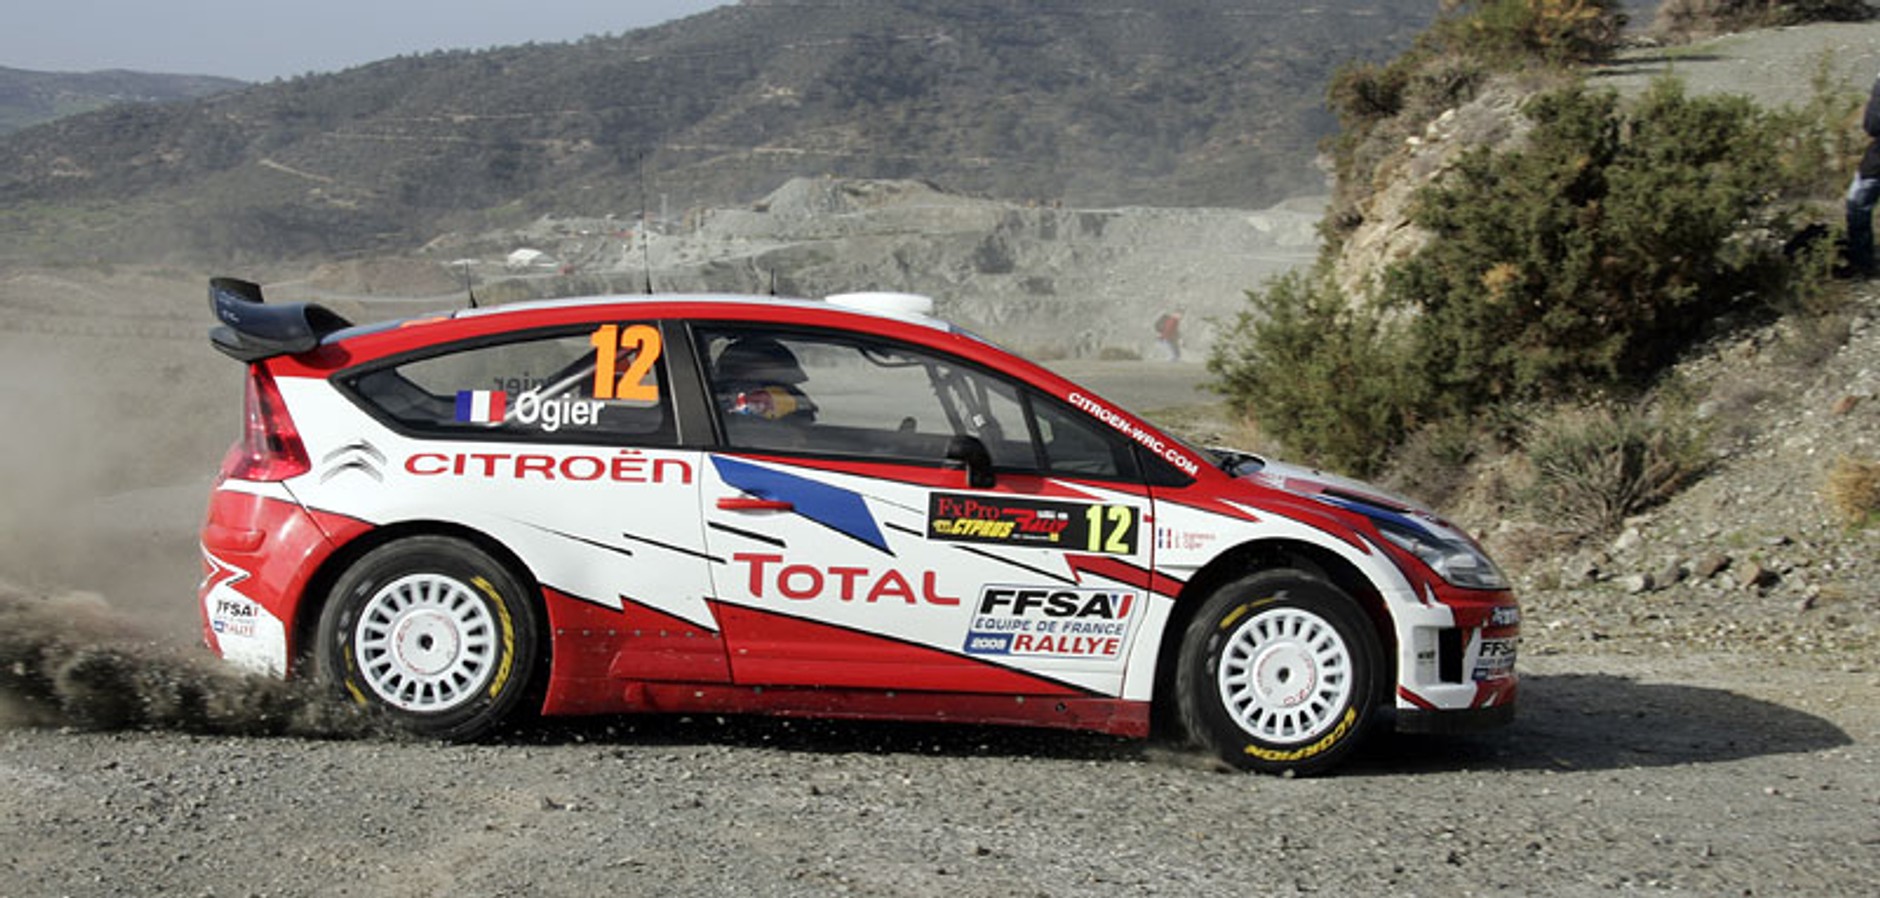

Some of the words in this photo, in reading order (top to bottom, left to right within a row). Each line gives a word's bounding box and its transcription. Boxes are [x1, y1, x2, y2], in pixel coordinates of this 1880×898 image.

[590, 324, 663, 401] 12
[516, 384, 606, 432] Ogier
[937, 497, 1000, 519] FxPro
[1086, 504, 1132, 554] 12
[732, 552, 961, 606] TOTAL
[979, 589, 1114, 620] FFSA
[974, 617, 1032, 631] EQUIPE
[1036, 620, 1054, 633] DE
[1062, 621, 1125, 636] FRANCE
[1013, 634, 1120, 656] RALLYE
